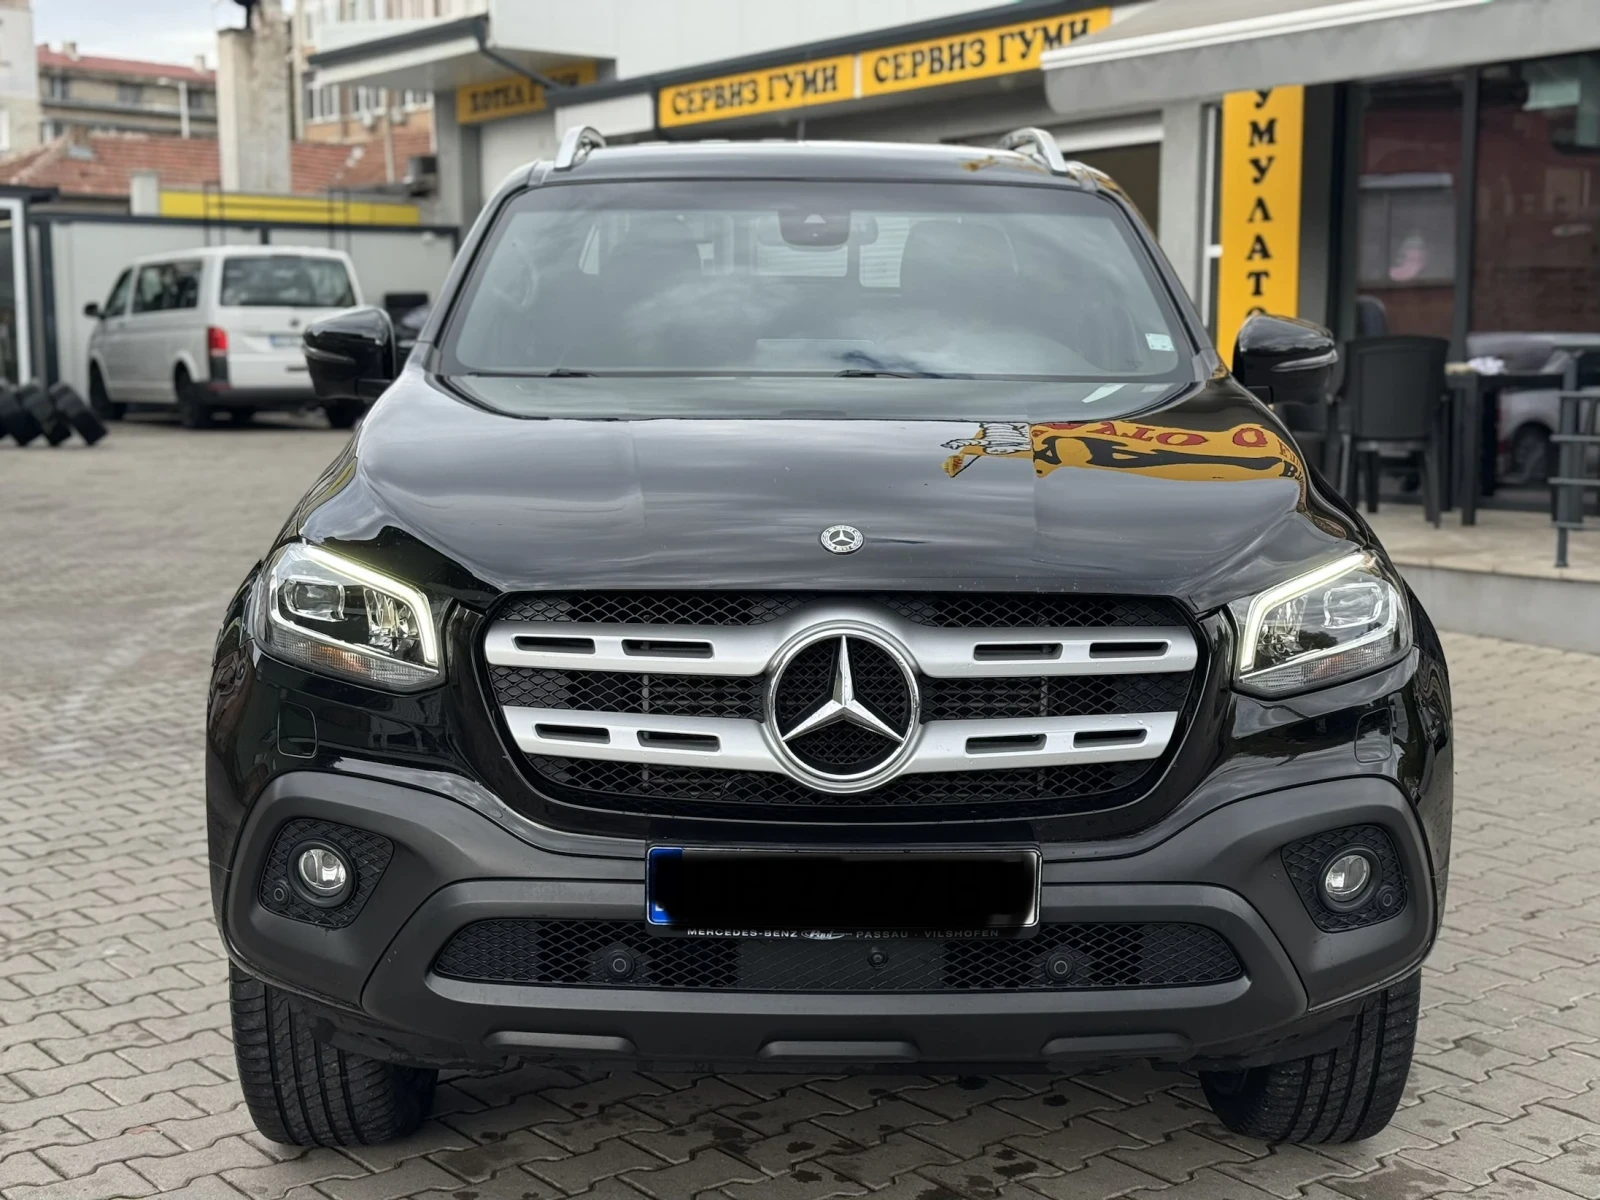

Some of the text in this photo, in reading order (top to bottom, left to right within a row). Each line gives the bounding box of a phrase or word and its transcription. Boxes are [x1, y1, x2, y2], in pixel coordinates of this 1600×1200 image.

[874, 38, 986, 84] СЕРВИЗ
[672, 65, 838, 115] СЕРВИЗ ГУМИ
[687, 928, 798, 938] MERCEDES-BENZ
[856, 931, 909, 939] PASSAU
[924, 930, 999, 938] VILSHOFEN
